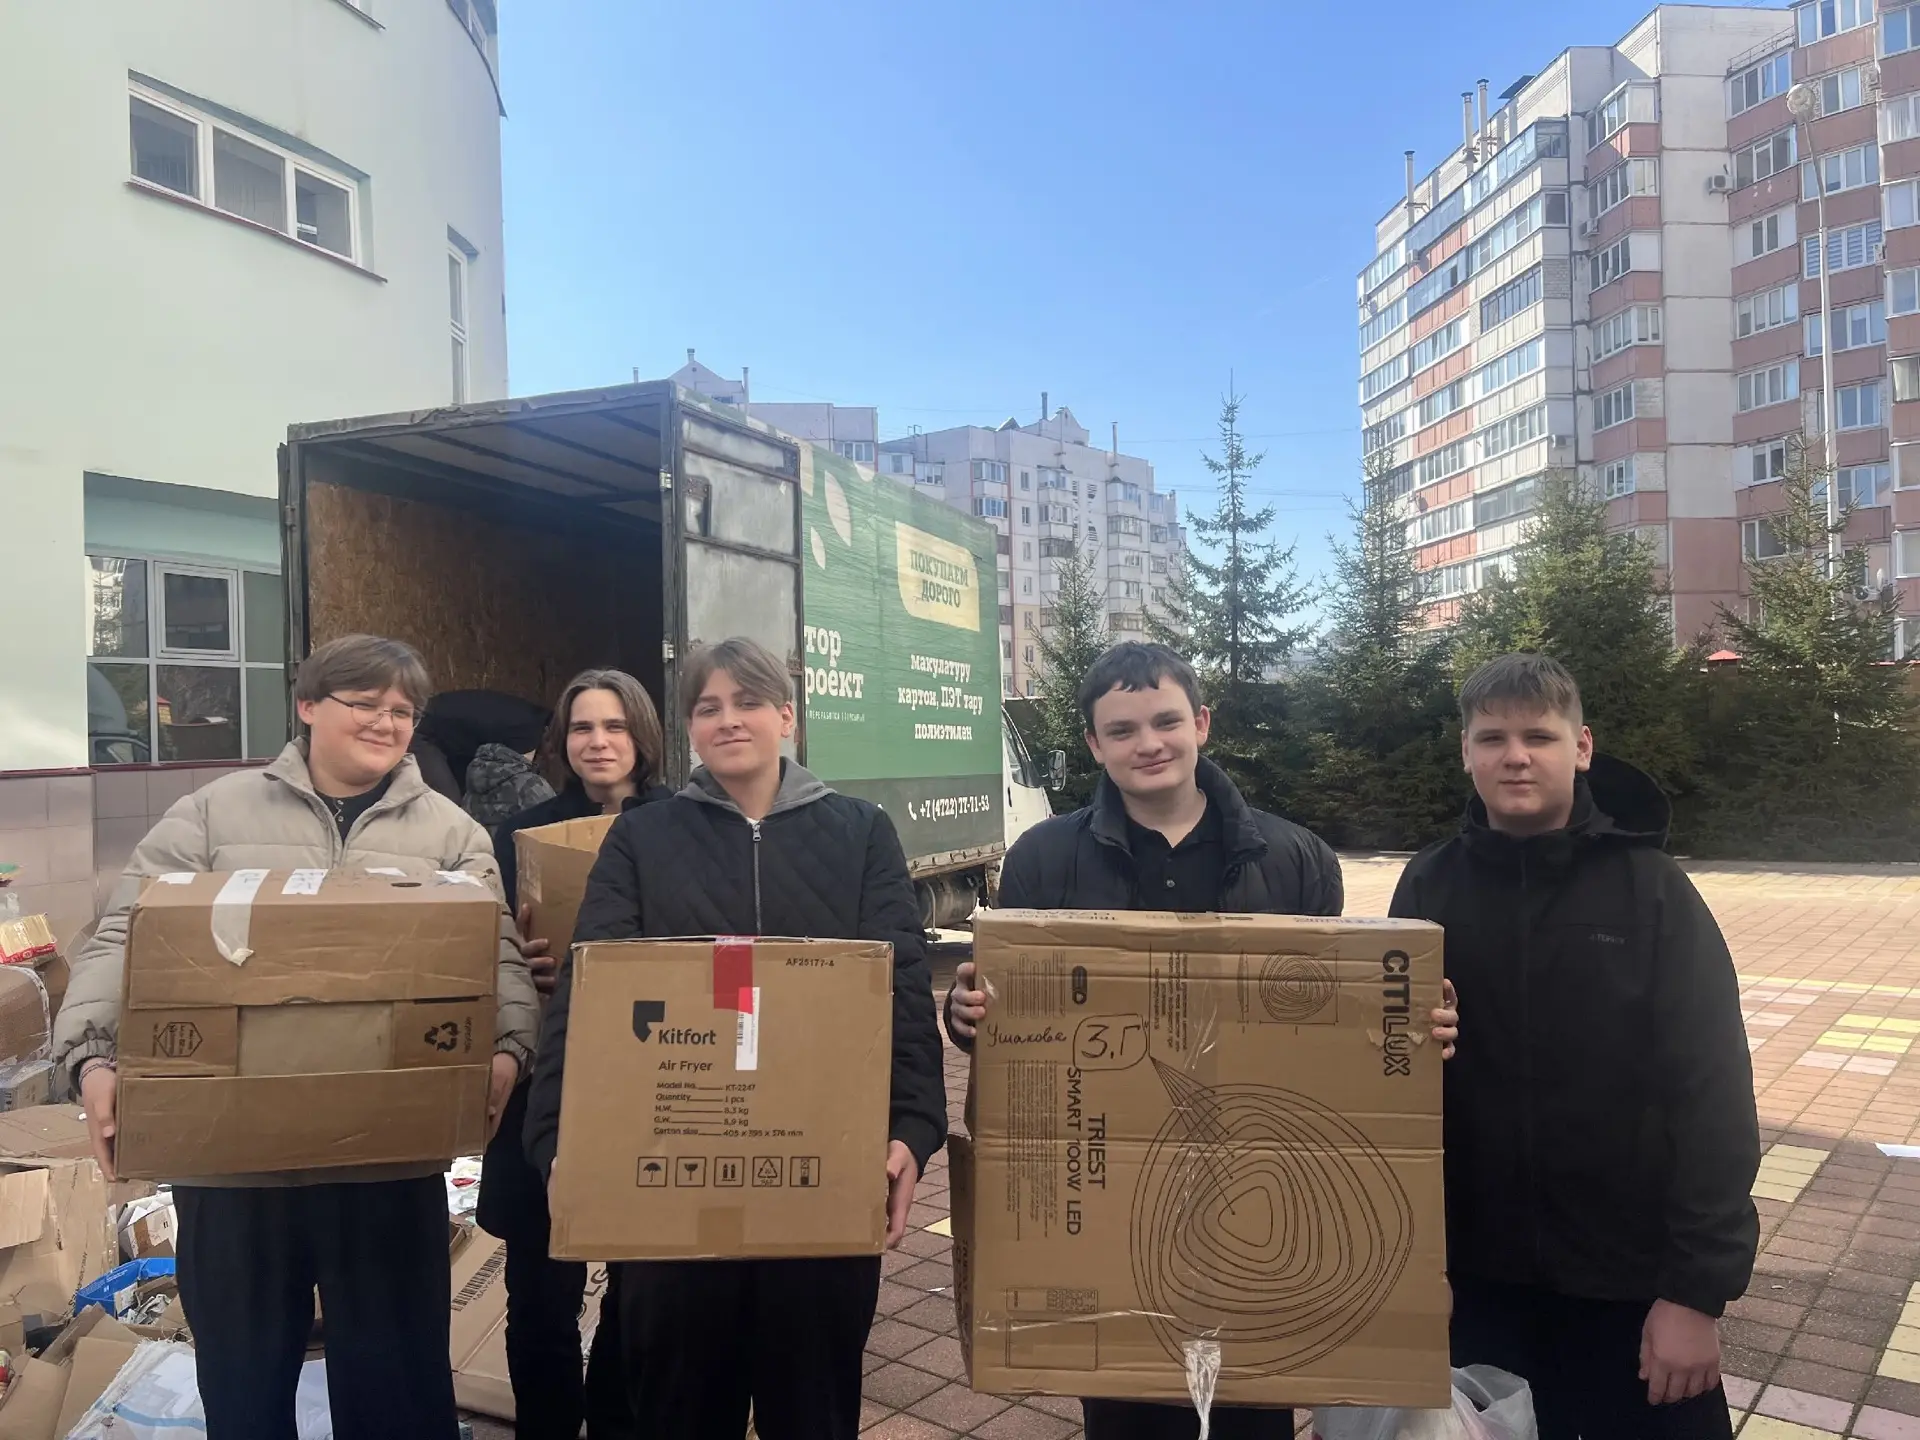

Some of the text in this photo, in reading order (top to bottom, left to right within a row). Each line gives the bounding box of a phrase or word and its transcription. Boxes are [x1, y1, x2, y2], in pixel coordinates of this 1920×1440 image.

[910, 549, 969, 588] ПОКУПАЕМ
[921, 579, 961, 608] ДОРОГО
[898, 685, 983, 716] картон, ПЭТ тару
[914, 723, 973, 740] полиэтилен
[919, 794, 990, 822] +7 (4722) 77-71-53
[1383, 949, 1411, 1076] CITILUX
[658, 1027, 716, 1045] Kitfort
[658, 1059, 713, 1074] Air Fryer
[730, 1096, 745, 1105] pcs
[738, 1106, 749, 1116] kg
[1066, 1066, 1081, 1132] SMART
[738, 1117, 749, 1127] kg
[1087, 1112, 1106, 1190] TRIEST
[1066, 1200, 1081, 1236] LED
